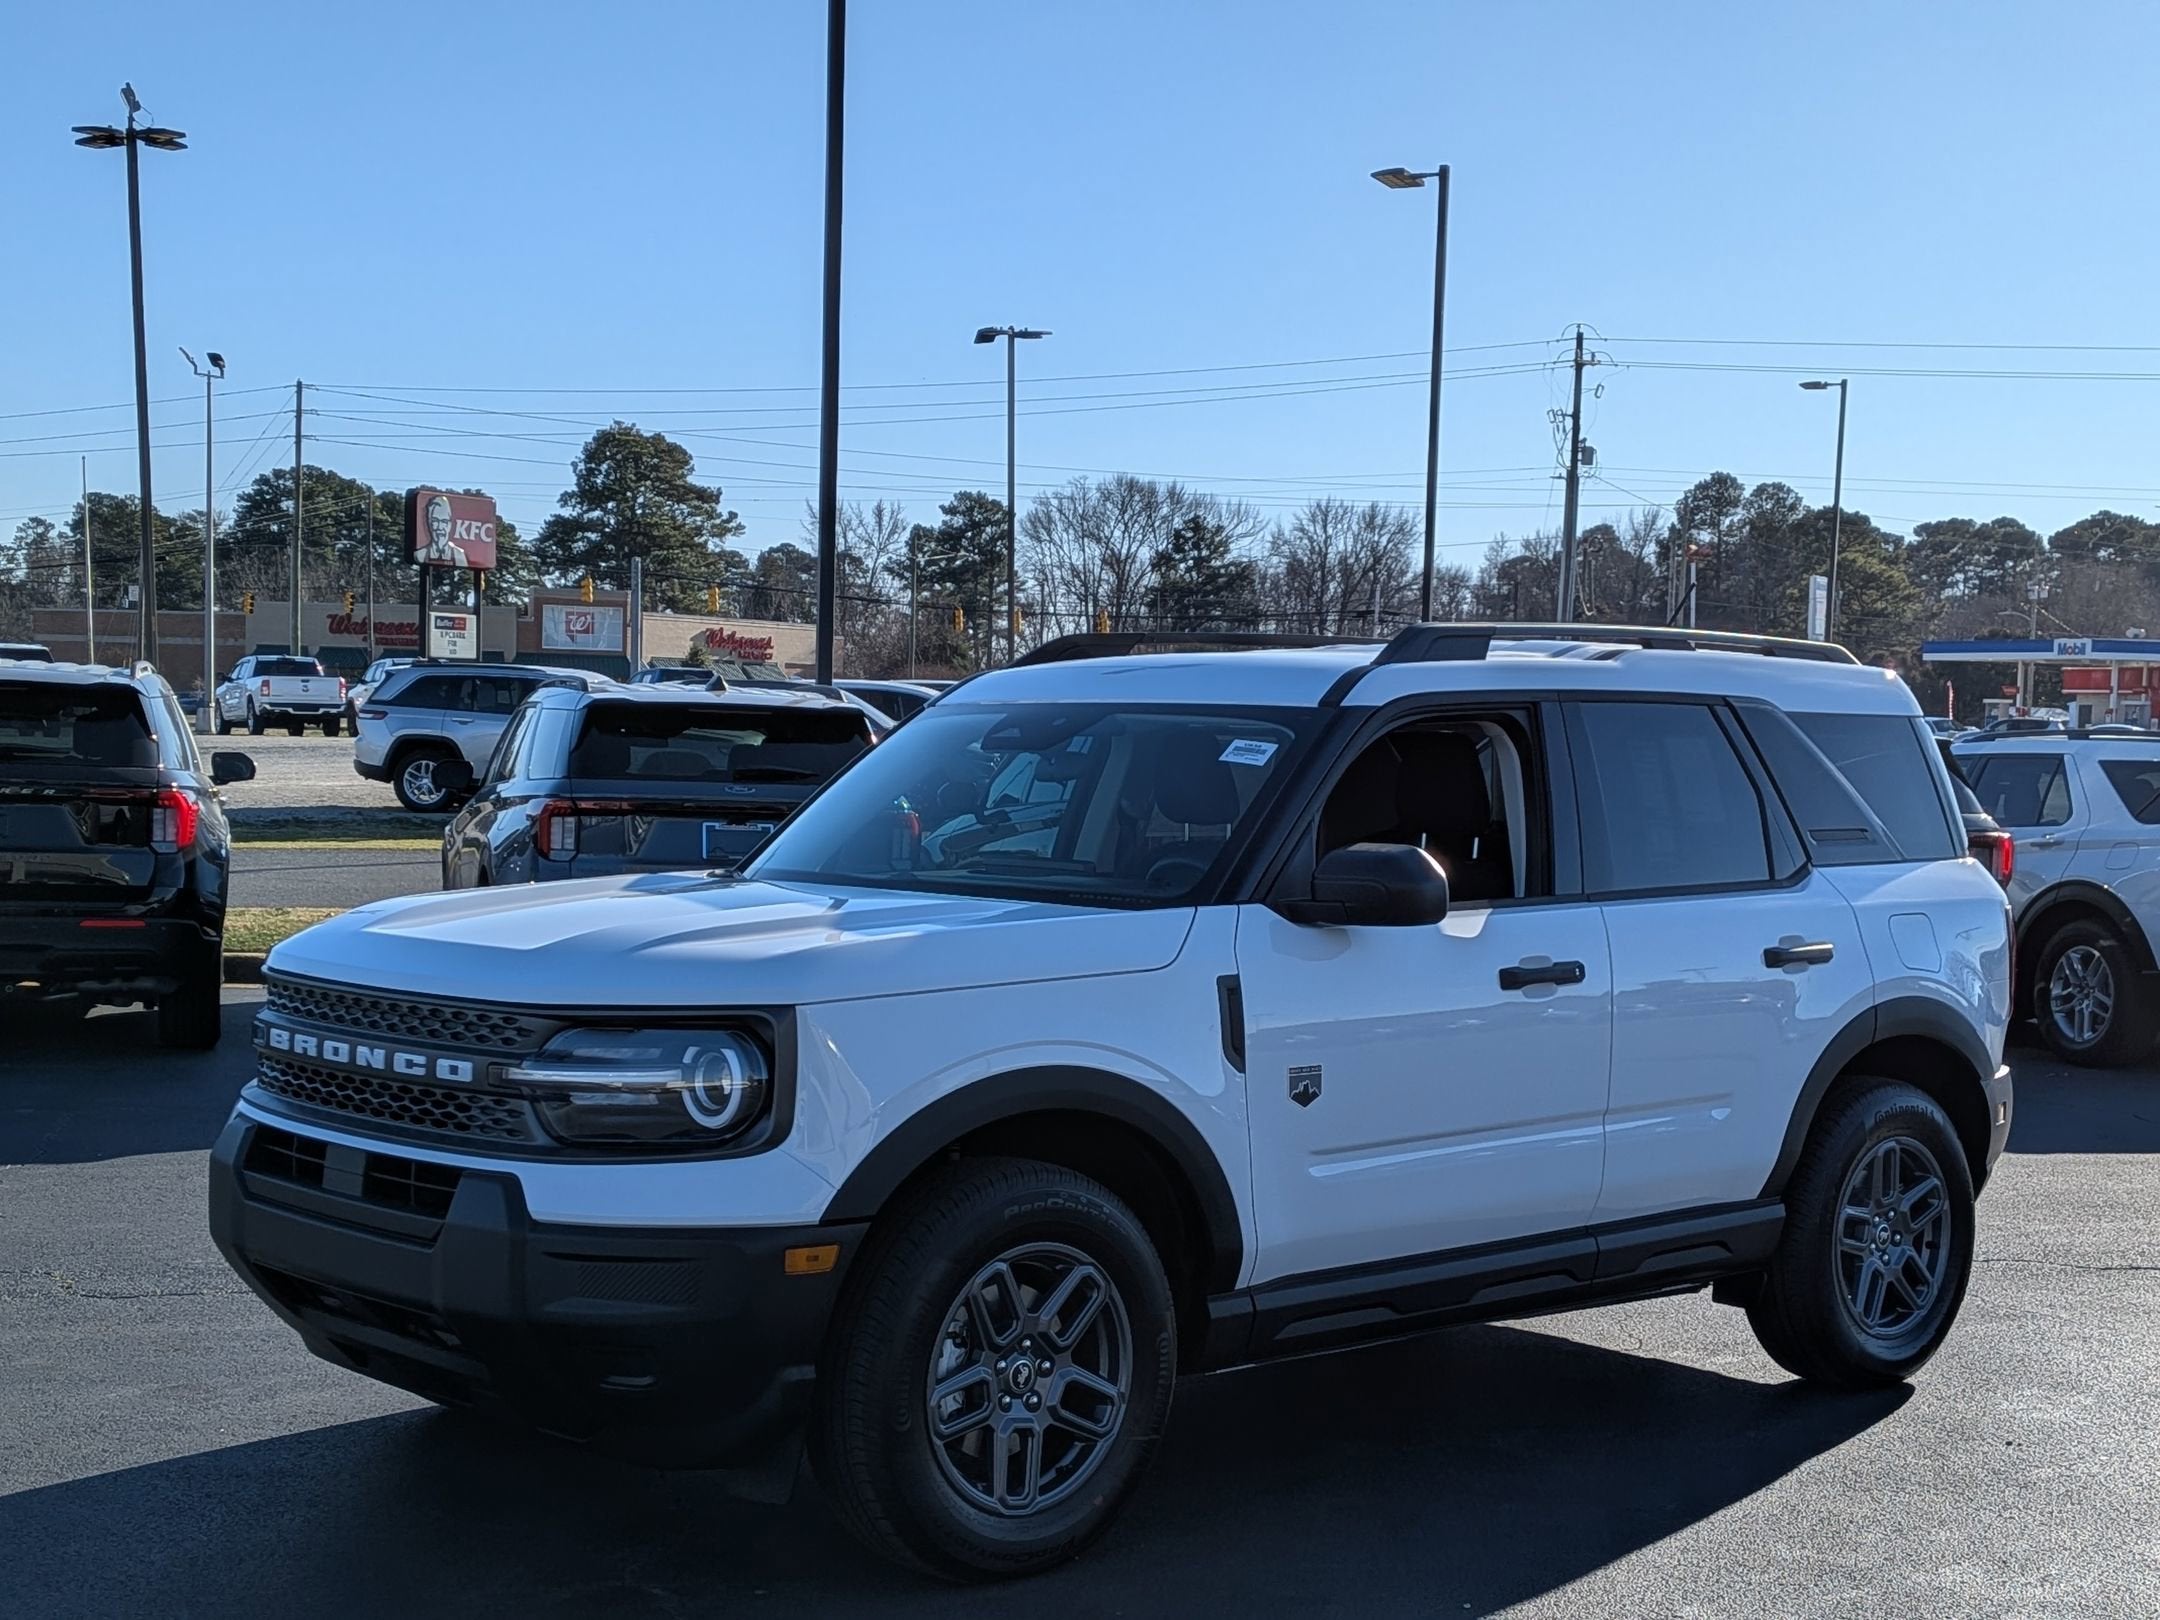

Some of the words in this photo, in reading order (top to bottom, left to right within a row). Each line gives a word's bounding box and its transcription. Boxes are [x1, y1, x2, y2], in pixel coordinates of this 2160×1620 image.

[453, 520, 494, 543] KFC
[704, 626, 774, 650] Walgreens
[2057, 642, 2087, 656] Mobil
[269, 1027, 474, 1083] BRONCO
[1874, 1103, 1929, 1124] Continental
